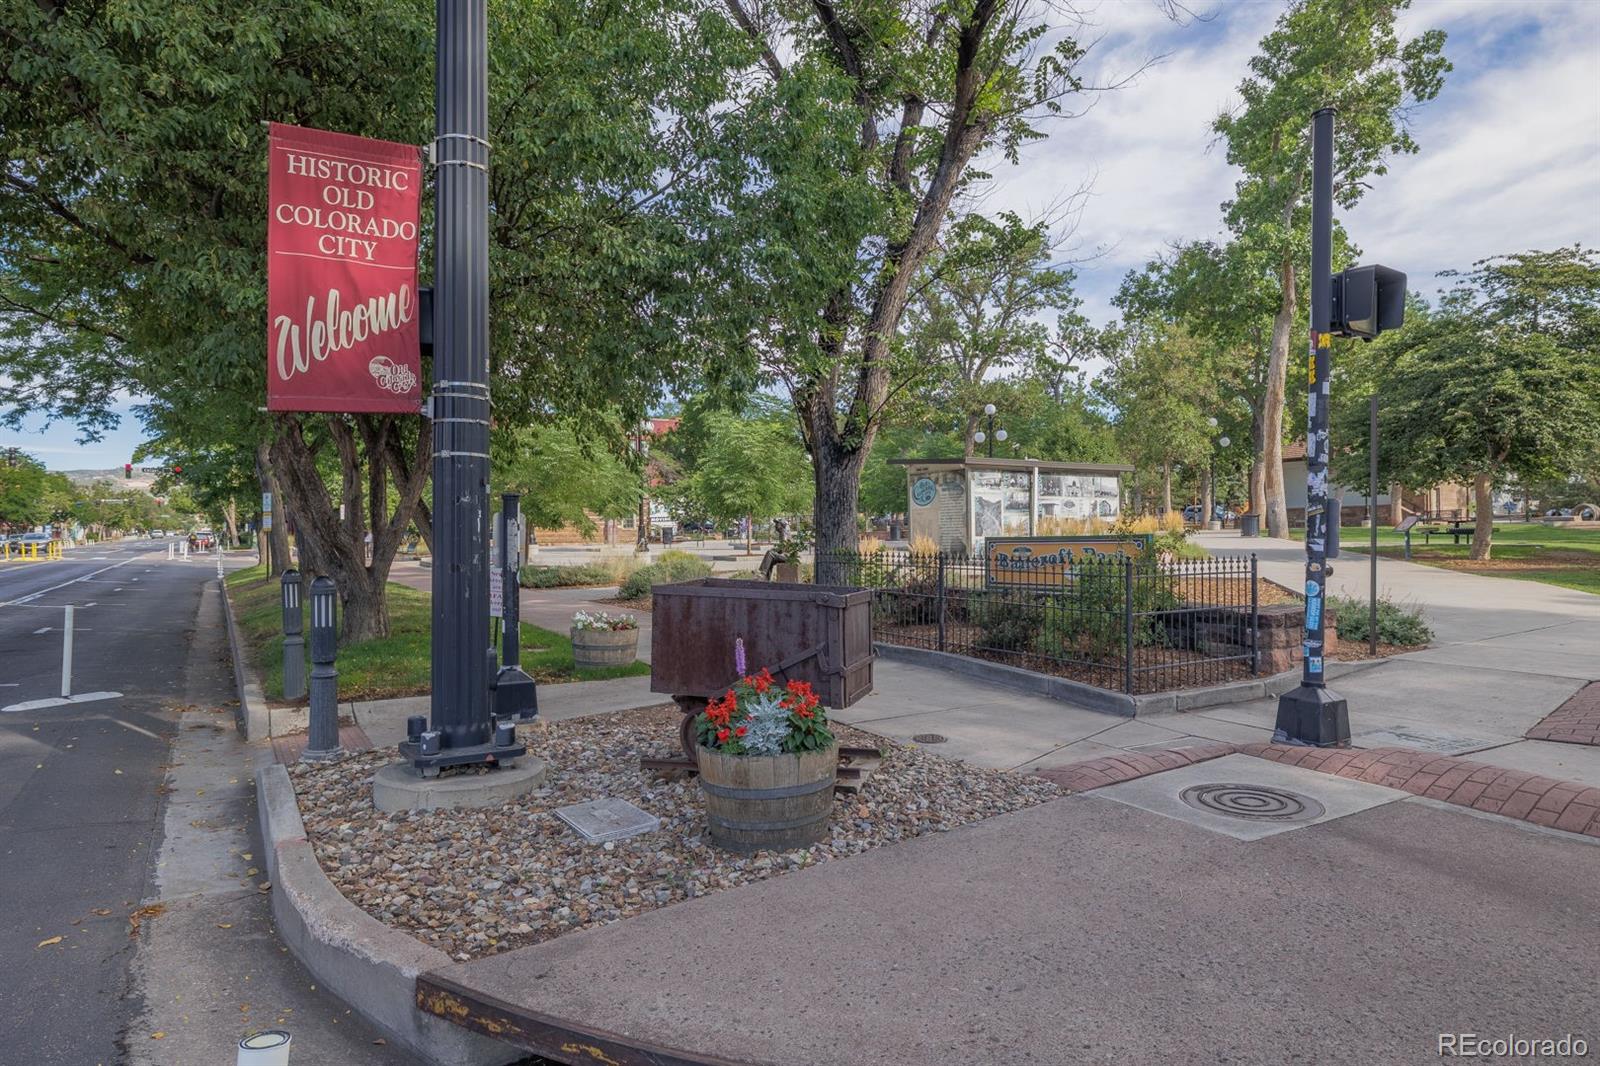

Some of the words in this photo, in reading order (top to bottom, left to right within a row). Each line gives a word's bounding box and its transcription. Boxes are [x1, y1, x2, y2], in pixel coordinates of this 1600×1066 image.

[287, 153, 409, 191] HISTORIC
[322, 185, 375, 210] OLD
[276, 203, 416, 241] COLORADO
[318, 234, 377, 261] CITY
[274, 283, 415, 381] Welcome
